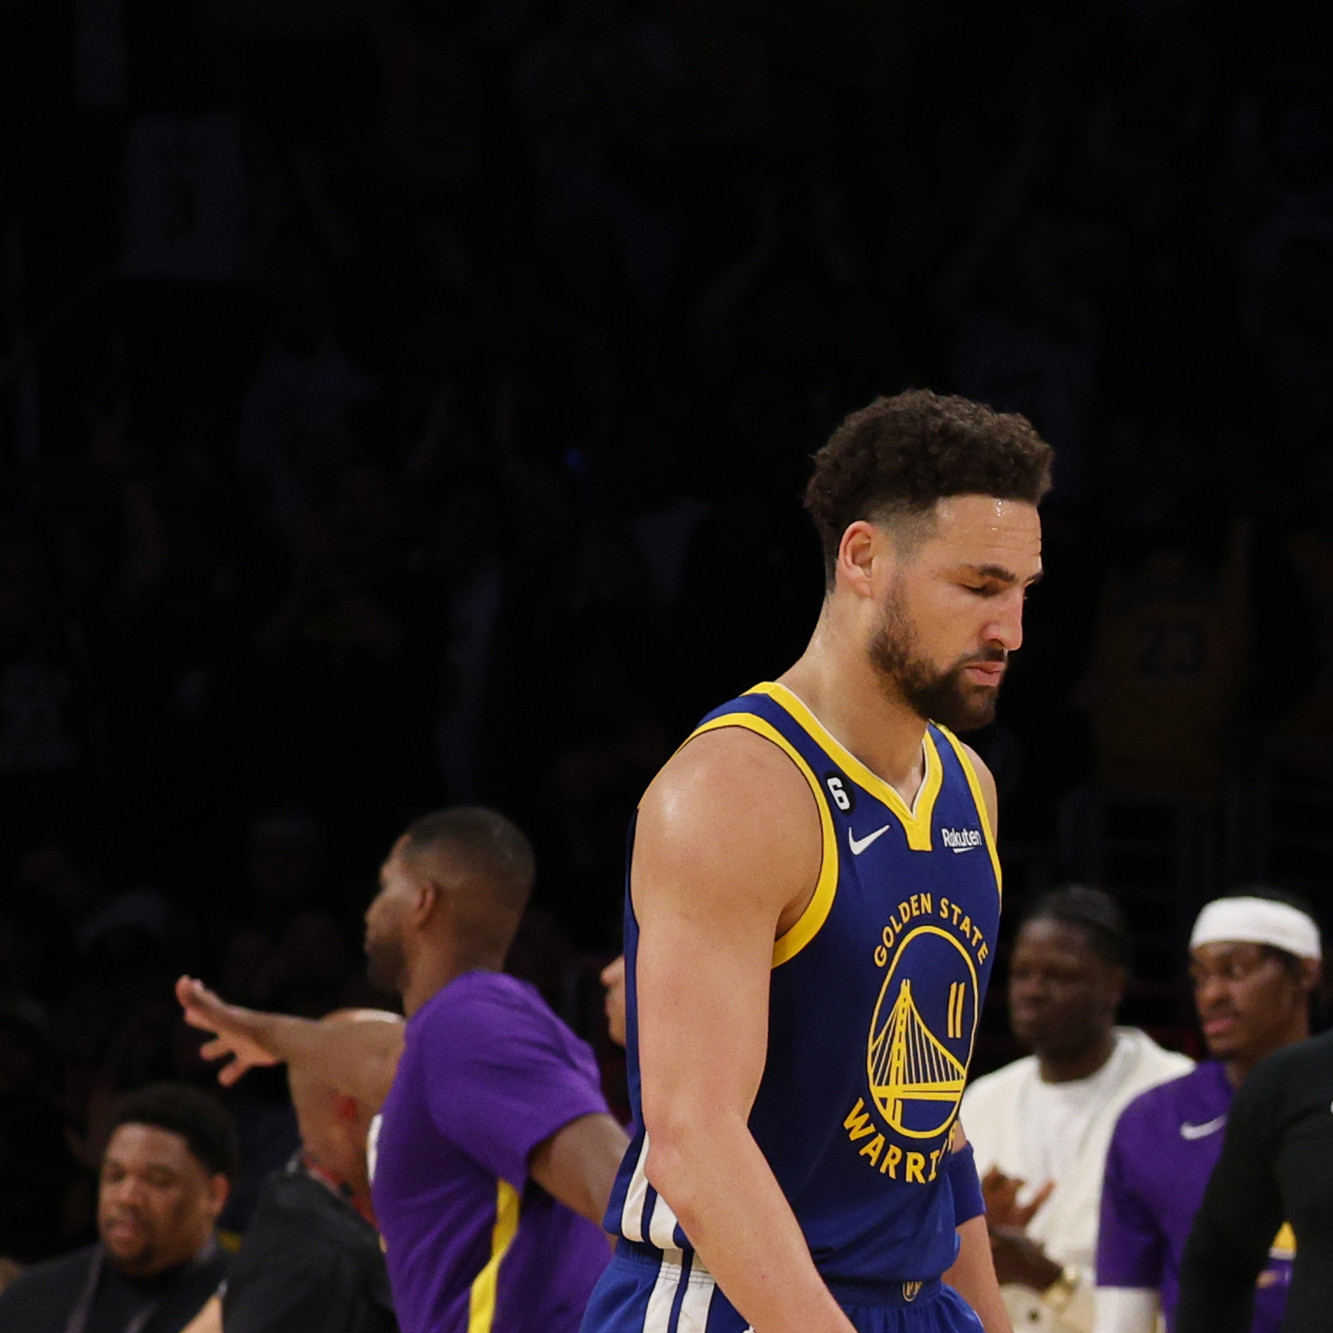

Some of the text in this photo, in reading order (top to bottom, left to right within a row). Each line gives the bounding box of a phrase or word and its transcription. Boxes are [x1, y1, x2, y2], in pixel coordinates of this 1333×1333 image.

[827, 777, 850, 810] 6
[941, 827, 982, 848] Rakuten
[874, 893, 989, 968] GOLDEN STATE
[948, 982, 965, 1039] 11
